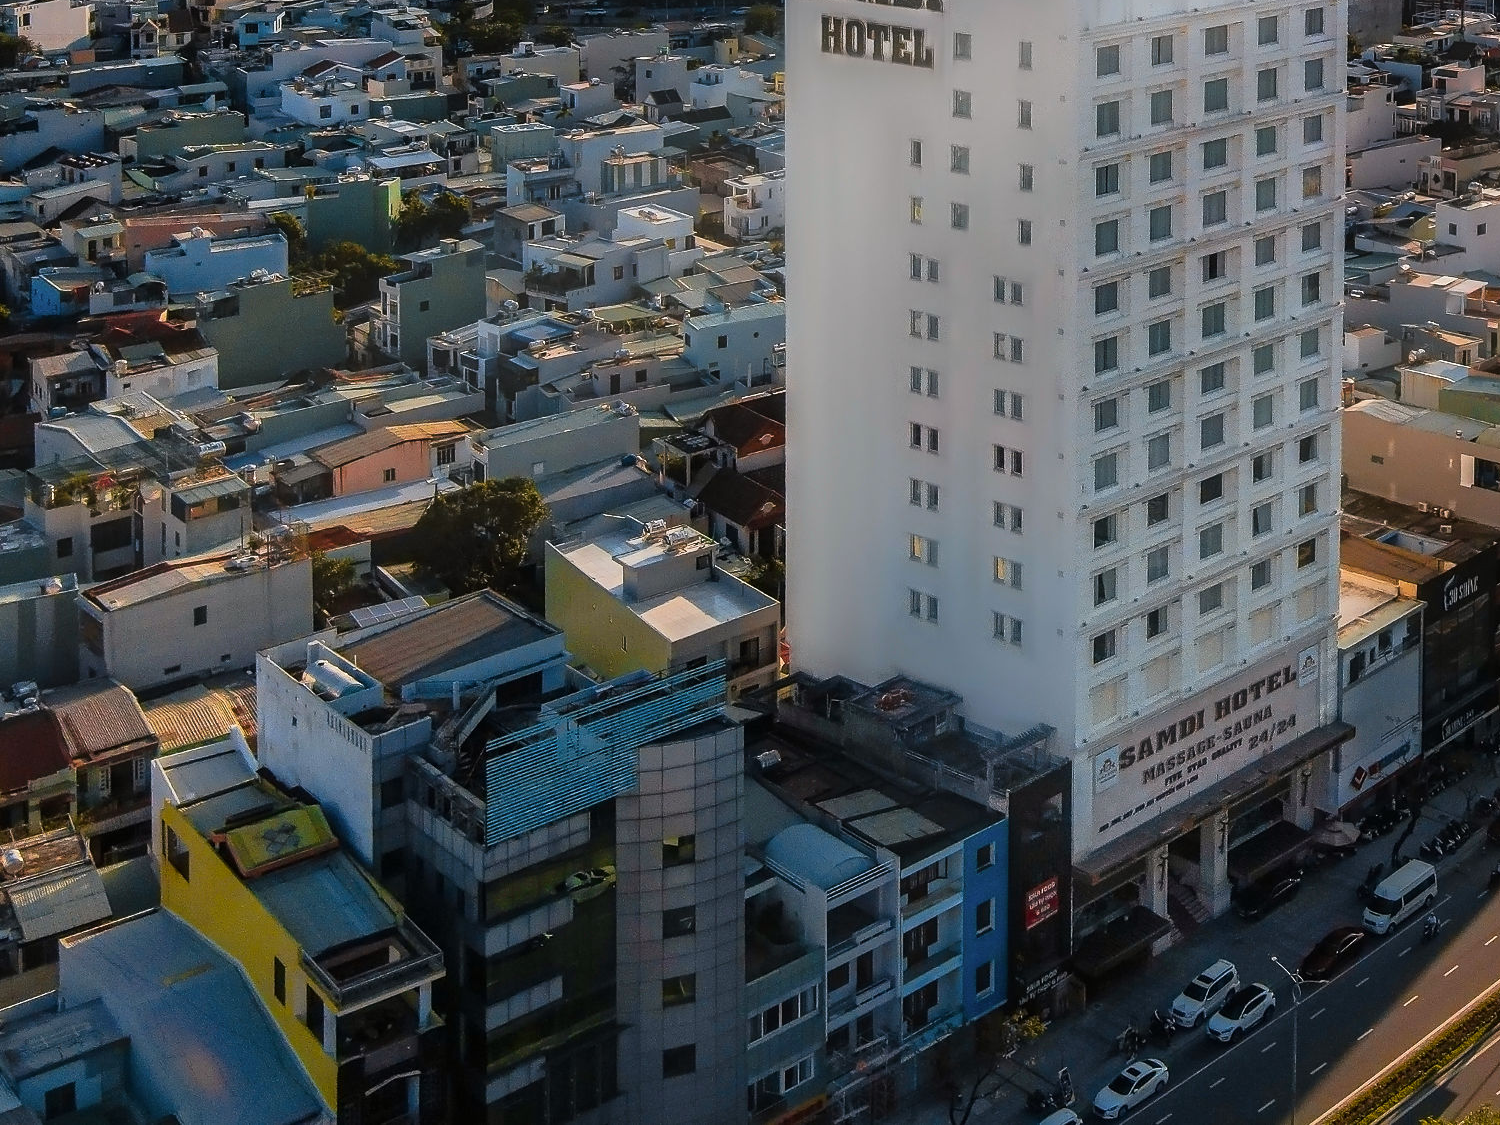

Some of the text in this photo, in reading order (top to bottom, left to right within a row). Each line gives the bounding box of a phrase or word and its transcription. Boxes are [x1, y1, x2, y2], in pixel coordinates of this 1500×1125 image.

[821, 15, 935, 70] HOTEL
[1118, 664, 1297, 771] SAMDI HOTEL
[1248, 713, 1297, 751] 24/24
